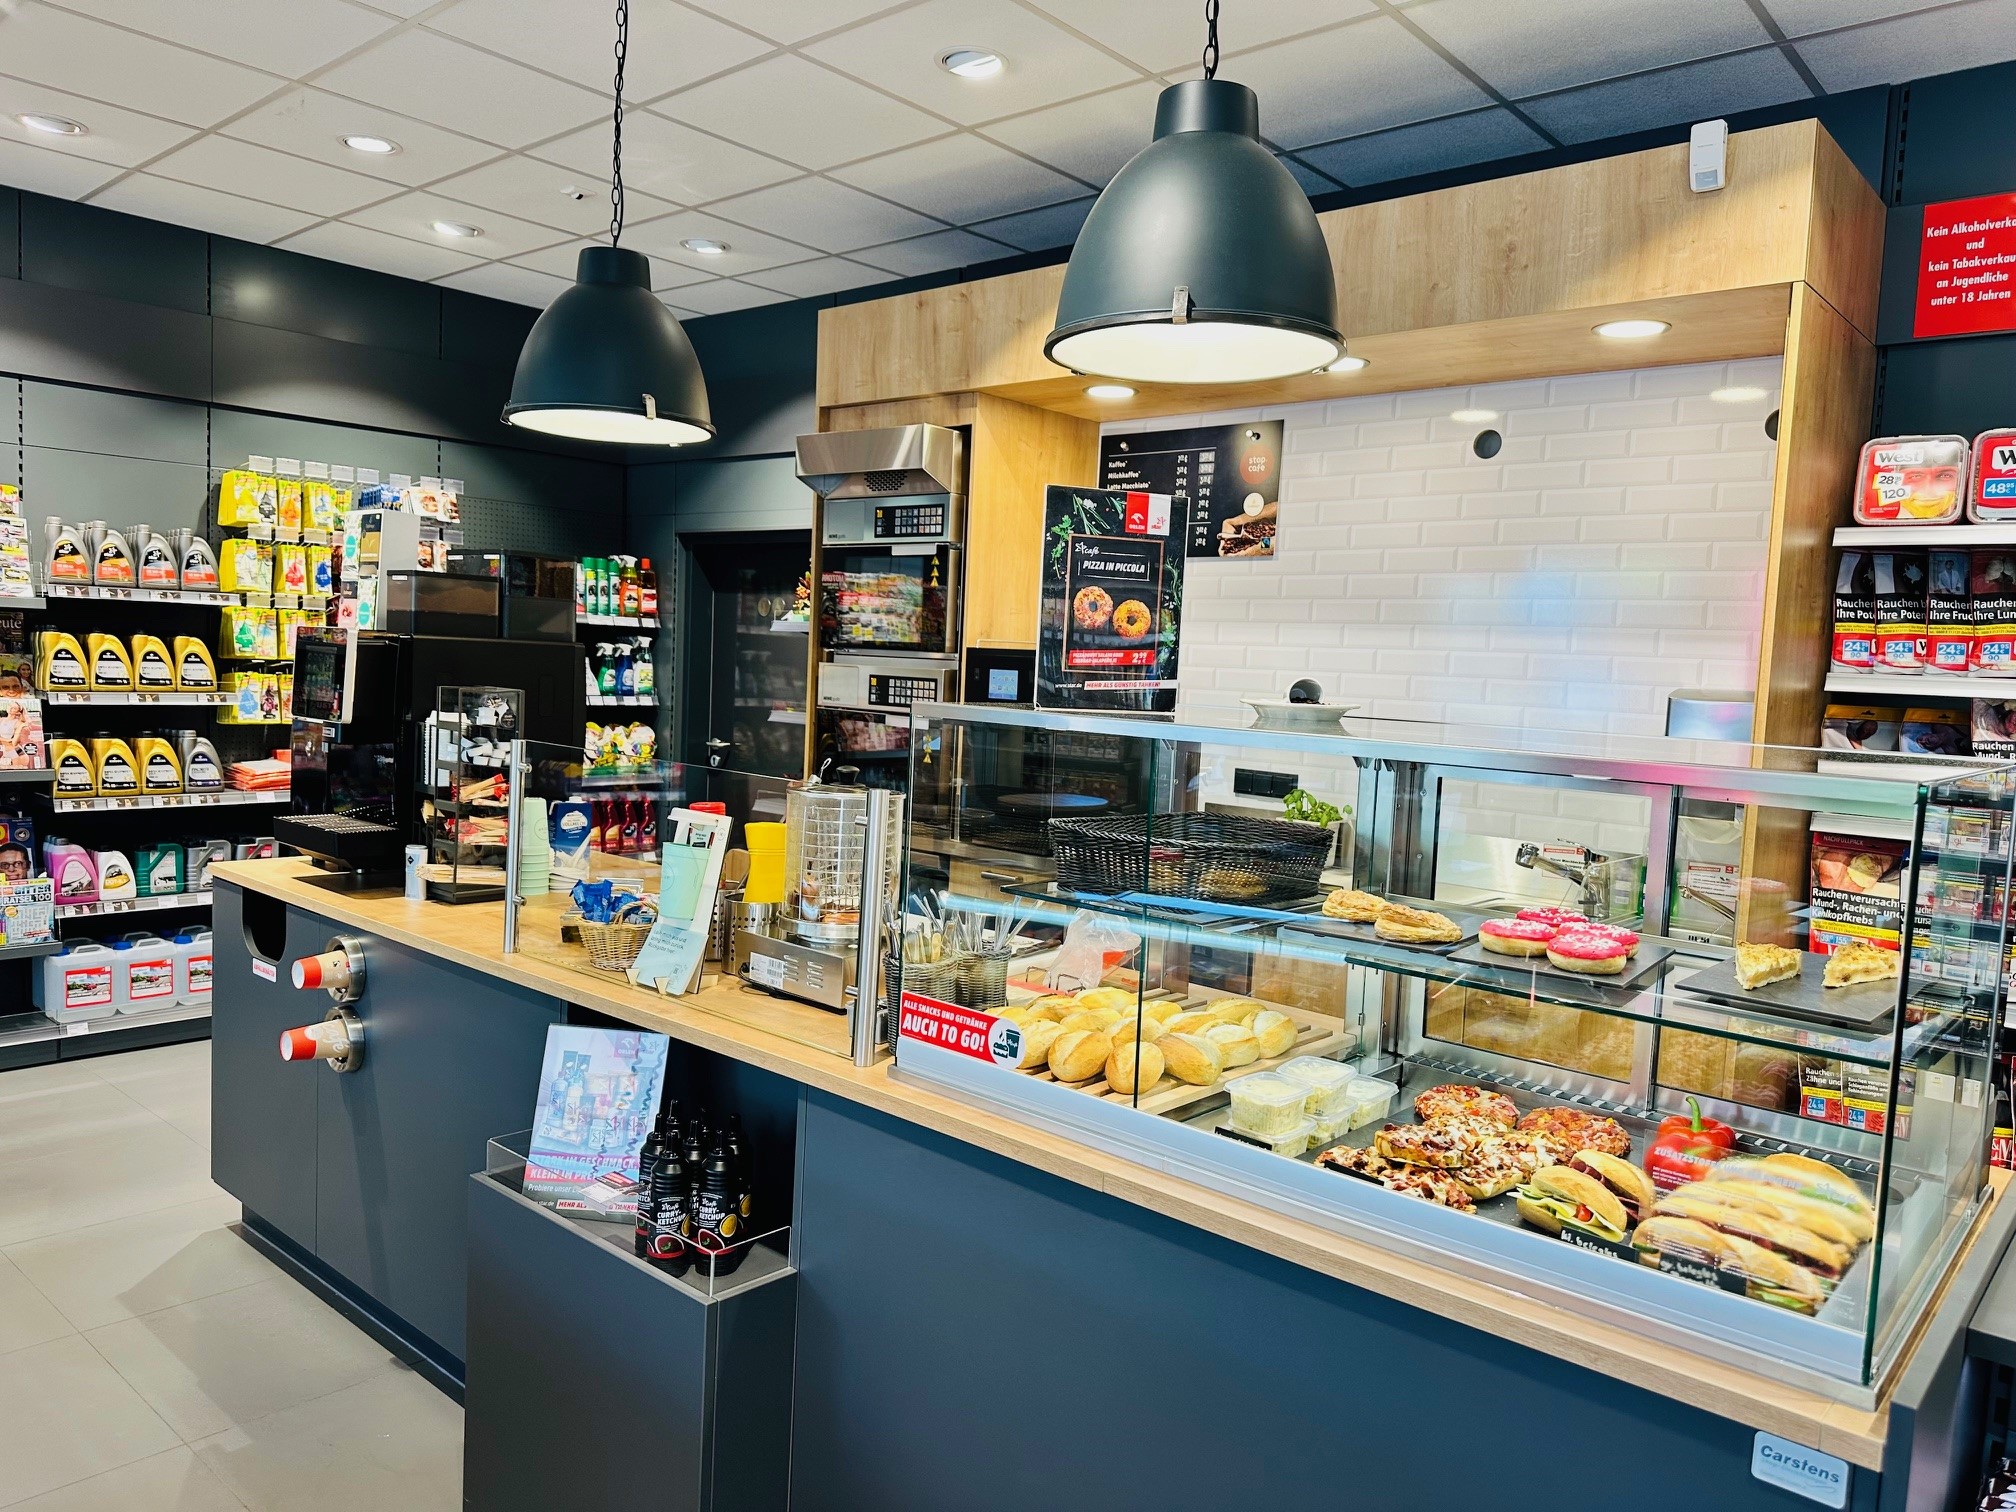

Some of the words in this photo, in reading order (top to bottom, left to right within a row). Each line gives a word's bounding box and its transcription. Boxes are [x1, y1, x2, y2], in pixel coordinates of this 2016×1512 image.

[1926, 226, 1949, 238] Kein
[1966, 238, 1985, 250] und
[1928, 260, 1949, 272] kein
[1936, 278, 1949, 288] an
[1951, 272, 2009, 289] Jugendliche
[1931, 296, 1958, 307] unter
[1961, 292, 1974, 303] 18
[1977, 289, 2011, 302] Jahren
[1248, 456, 1266, 465] stop
[1878, 451, 1919, 463] West
[1882, 487, 1906, 499] 120
[1083, 560, 1105, 570] PIZZA
[1105, 562, 1115, 571] IN
[1115, 563, 1146, 573] PICCOLA
[1877, 599, 1919, 609] Rauchen
[1836, 609, 1855, 619] Ihre
[1877, 610, 1898, 620] Ihre
[1929, 611, 1951, 621] Ihre
[1974, 611, 1994, 621] Ihre
[1972, 742, 2014, 751] Rauchen
[1812, 887, 1848, 900] Rauchen
[1812, 898, 1840, 910] Mund-,
[1842, 903, 1882, 916] Rachen-
[1812, 909, 1873, 925] Kehlkopfkrebs
[903, 1000, 918, 1011] ALLE
[917, 1003, 941, 1018] SNACKS
[941, 1010, 955, 1021] UND
[955, 1014, 988, 1031] GETRÄNKE
[902, 1013, 939, 1038] AUCH
[941, 1023, 959, 1044] TO
[960, 1030, 986, 1053] GO!
[1805, 1067, 1835, 1077] Rauchen
[1806, 1075, 1827, 1084] Zähne
[580, 1156, 638, 1170] GESCHMACK.
[530, 1168, 560, 1180] KLEIN
[527, 1183, 553, 1193] Probiere
[657, 1210, 682, 1218] CURRY-
[657, 1213, 686, 1226] KETCHUP
[1760, 1444, 1840, 1484] Carstens
